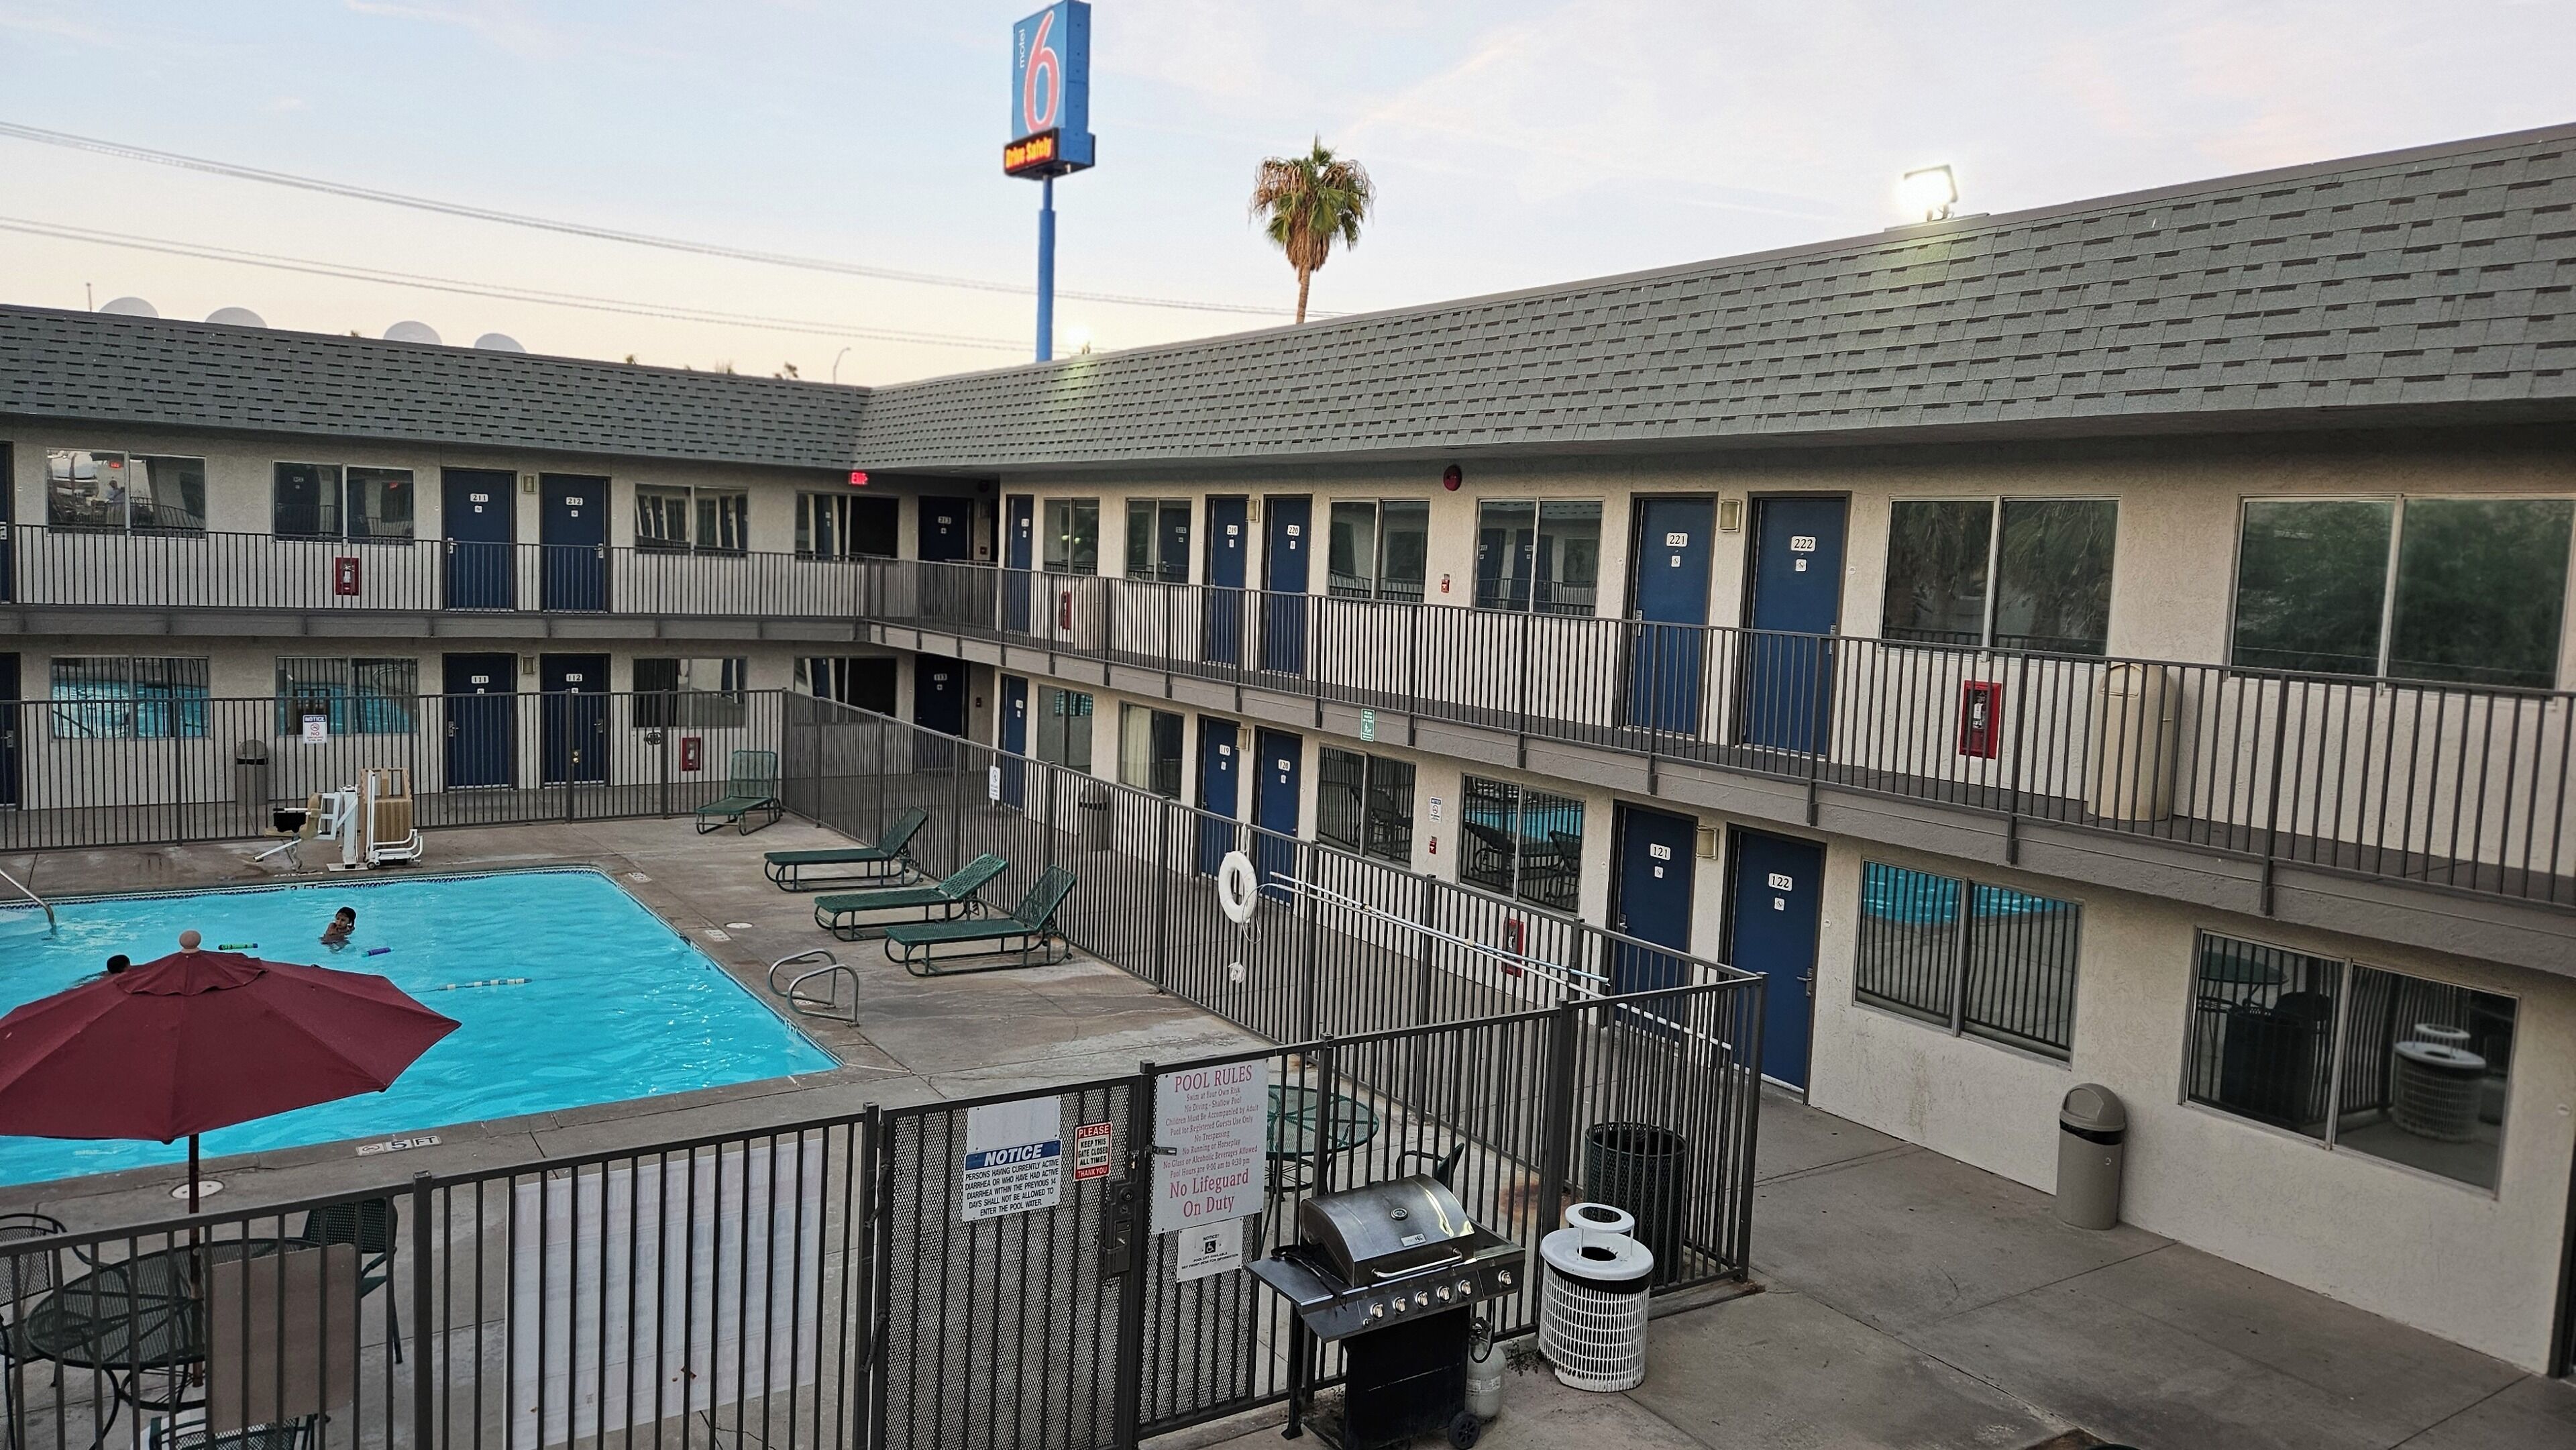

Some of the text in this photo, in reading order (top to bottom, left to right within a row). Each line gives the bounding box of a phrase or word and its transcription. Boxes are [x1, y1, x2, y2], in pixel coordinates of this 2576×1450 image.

[1024, 9, 1060, 134] 6
[1289, 526, 1299, 534] 220
[1670, 535, 1685, 545] 221
[1794, 538, 1813, 549] 222
[1280, 761, 1289, 770] 120
[1654, 846, 1668, 858] 121
[1772, 875, 1789, 888] 122
[1175, 1065, 1252, 1092] POOL RULES
[1218, 1088, 1229, 1096] Own
[1230, 1086, 1240, 1094] Risk
[1185, 1104, 1191, 1112] No
[1193, 1102, 1208, 1112] Diving
[1212, 1099, 1230, 1108] Shallow
[1165, 1117, 1186, 1127] Children
[1187, 1114, 1199, 1123] Must
[1208, 1107, 1239, 1119] Accompanied
[1079, 1125, 1110, 1138] PLEASE
[1190, 1122, 1215, 1133] Registered
[1216, 1119, 1232, 1128] Guests
[1202, 1131, 1230, 1141] Trespassing
[391, 1137, 435, 1149] 5 FT
[1081, 1138, 1106, 1149] KEEP THIS
[1191, 1144, 1210, 1153] Running
[1218, 1139, 1240, 1149] Horseplay
[984, 1144, 1044, 1166] NOTICE
[1078, 1147, 1108, 1158] GATE CLOSED
[1163, 1161, 1171, 1169] No
[1171, 1158, 1185, 1168] Glass
[1215, 1149, 1238, 1159] Beverages
[1239, 1145, 1258, 1155] Allowed
[1091, 1155, 1107, 1164] TIMES
[966, 1159, 1059, 1181] PERSONS HAVING CURRENTLY ACTIVE
[1078, 1166, 1108, 1178] THANK YOU
[1181, 1168, 1196, 1176] Hours
[965, 1180, 991, 1191] DIARRHEA
[1002, 1176, 1014, 1184] WHO
[1016, 1173, 1028, 1182] HAVE
[1030, 1172, 1040, 1180] HAD
[1042, 1168, 1059, 1177] ACTIVE
[1169, 1168, 1249, 1198] No Lifeguard
[967, 1178, 1057, 1200] DIARRHEA WITHIN THE PREVIOUS 14
[969, 1200, 982, 1208] DAYS
[983, 1197, 1000, 1206] SHALL
[1001, 1194, 1012, 1203] NOT
[1022, 1190, 1046, 1200] ALLOWED
[980, 1208, 997, 1216] ENTER
[1010, 1202, 1023, 1210] POOL
[1183, 1194, 1235, 1218] On Duty
